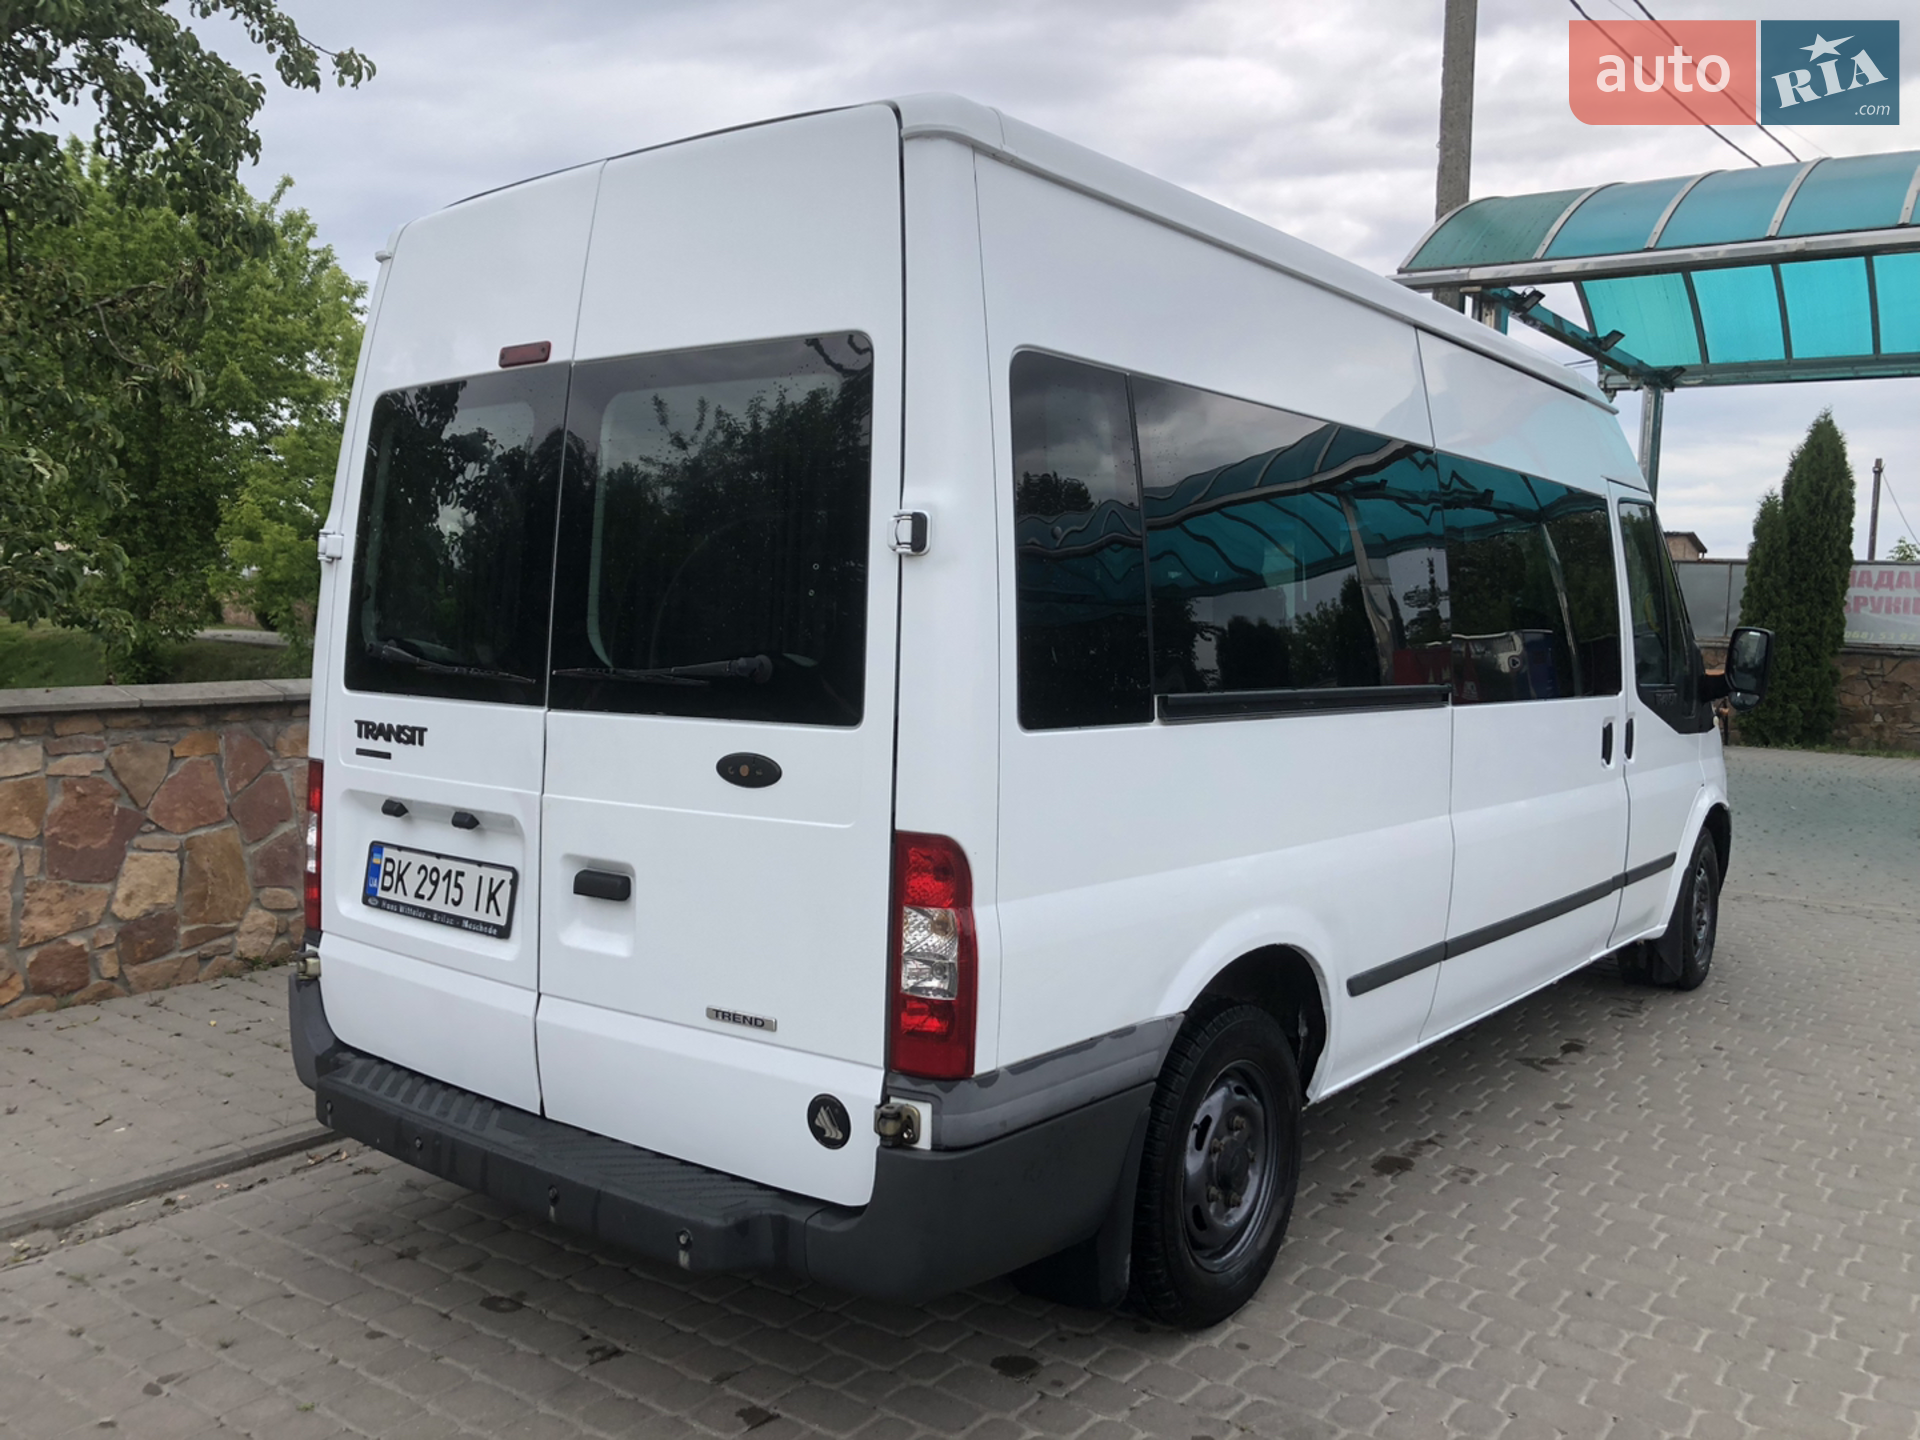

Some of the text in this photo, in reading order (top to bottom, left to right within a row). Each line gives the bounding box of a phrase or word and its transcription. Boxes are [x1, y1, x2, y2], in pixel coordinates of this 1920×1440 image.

[354, 719, 428, 747] TRANSIT
[381, 857, 505, 917] BK 2915 IK
[712, 1009, 765, 1028] TREND
